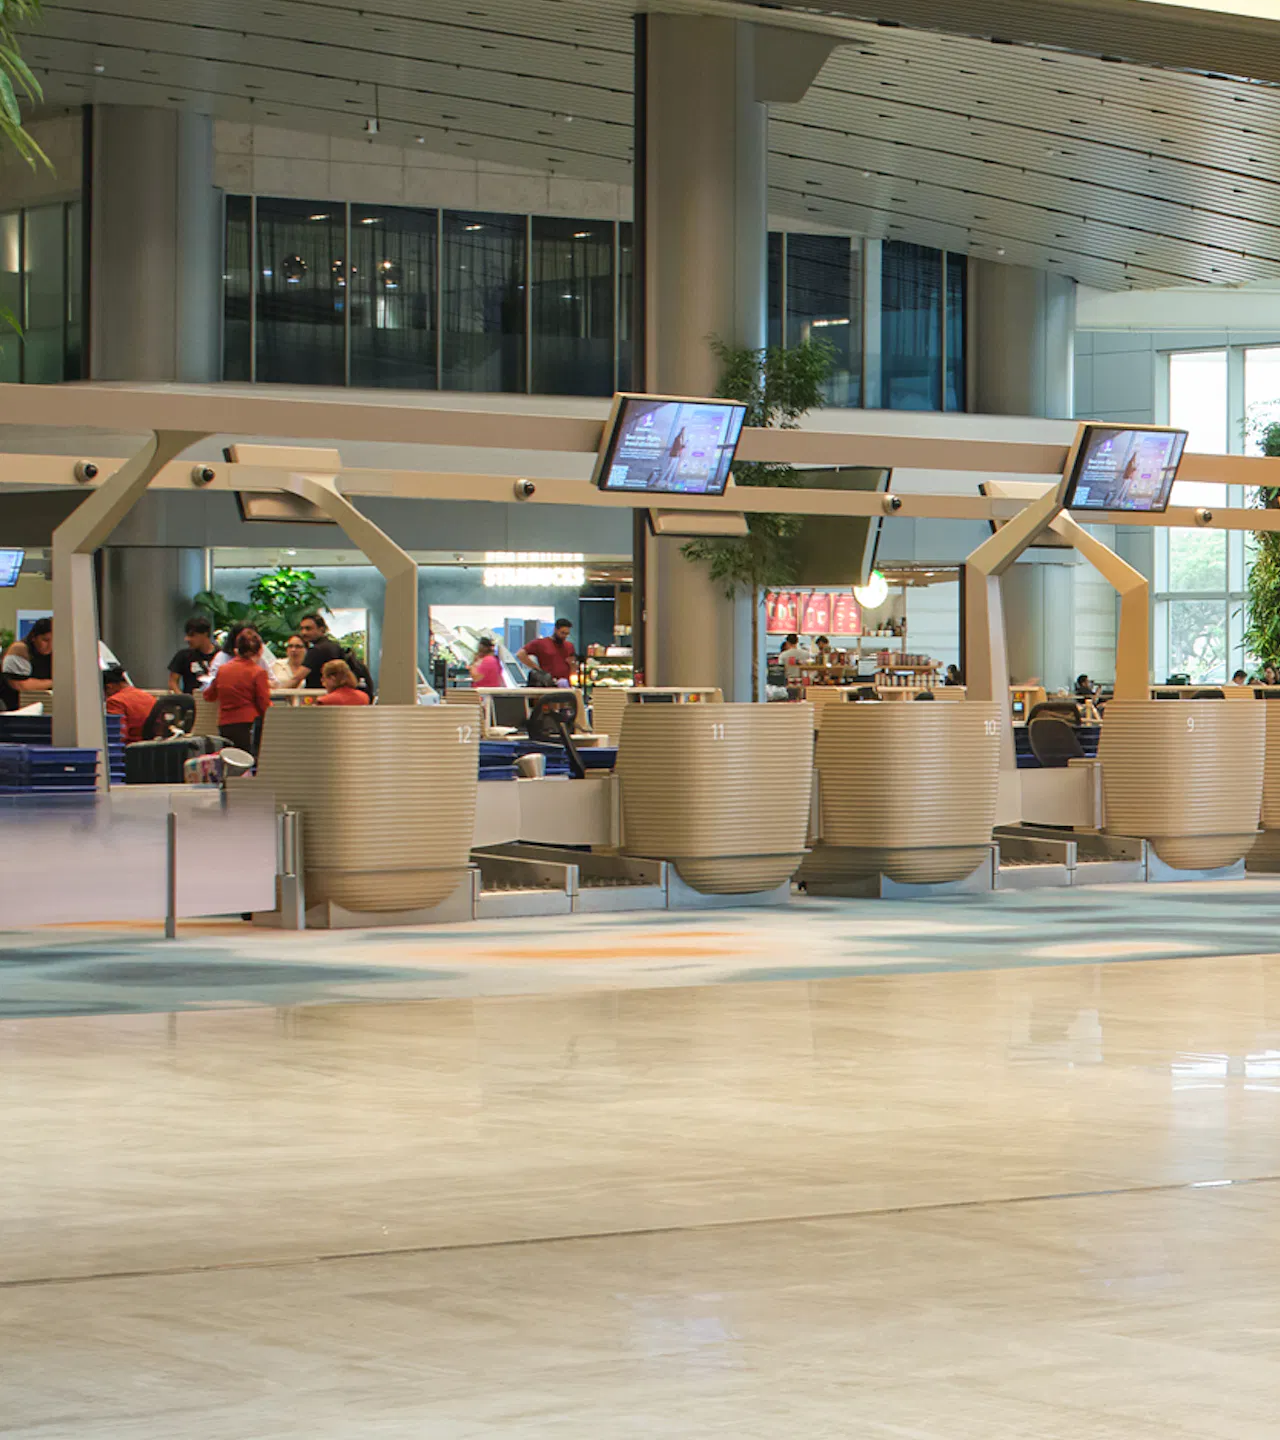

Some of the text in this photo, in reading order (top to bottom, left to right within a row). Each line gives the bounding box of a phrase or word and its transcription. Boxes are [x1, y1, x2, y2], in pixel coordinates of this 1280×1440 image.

[711, 723, 725, 741] 11
[983, 720, 996, 736] 10
[1186, 716, 1195, 732] 9
[456, 725, 472, 744] 12
